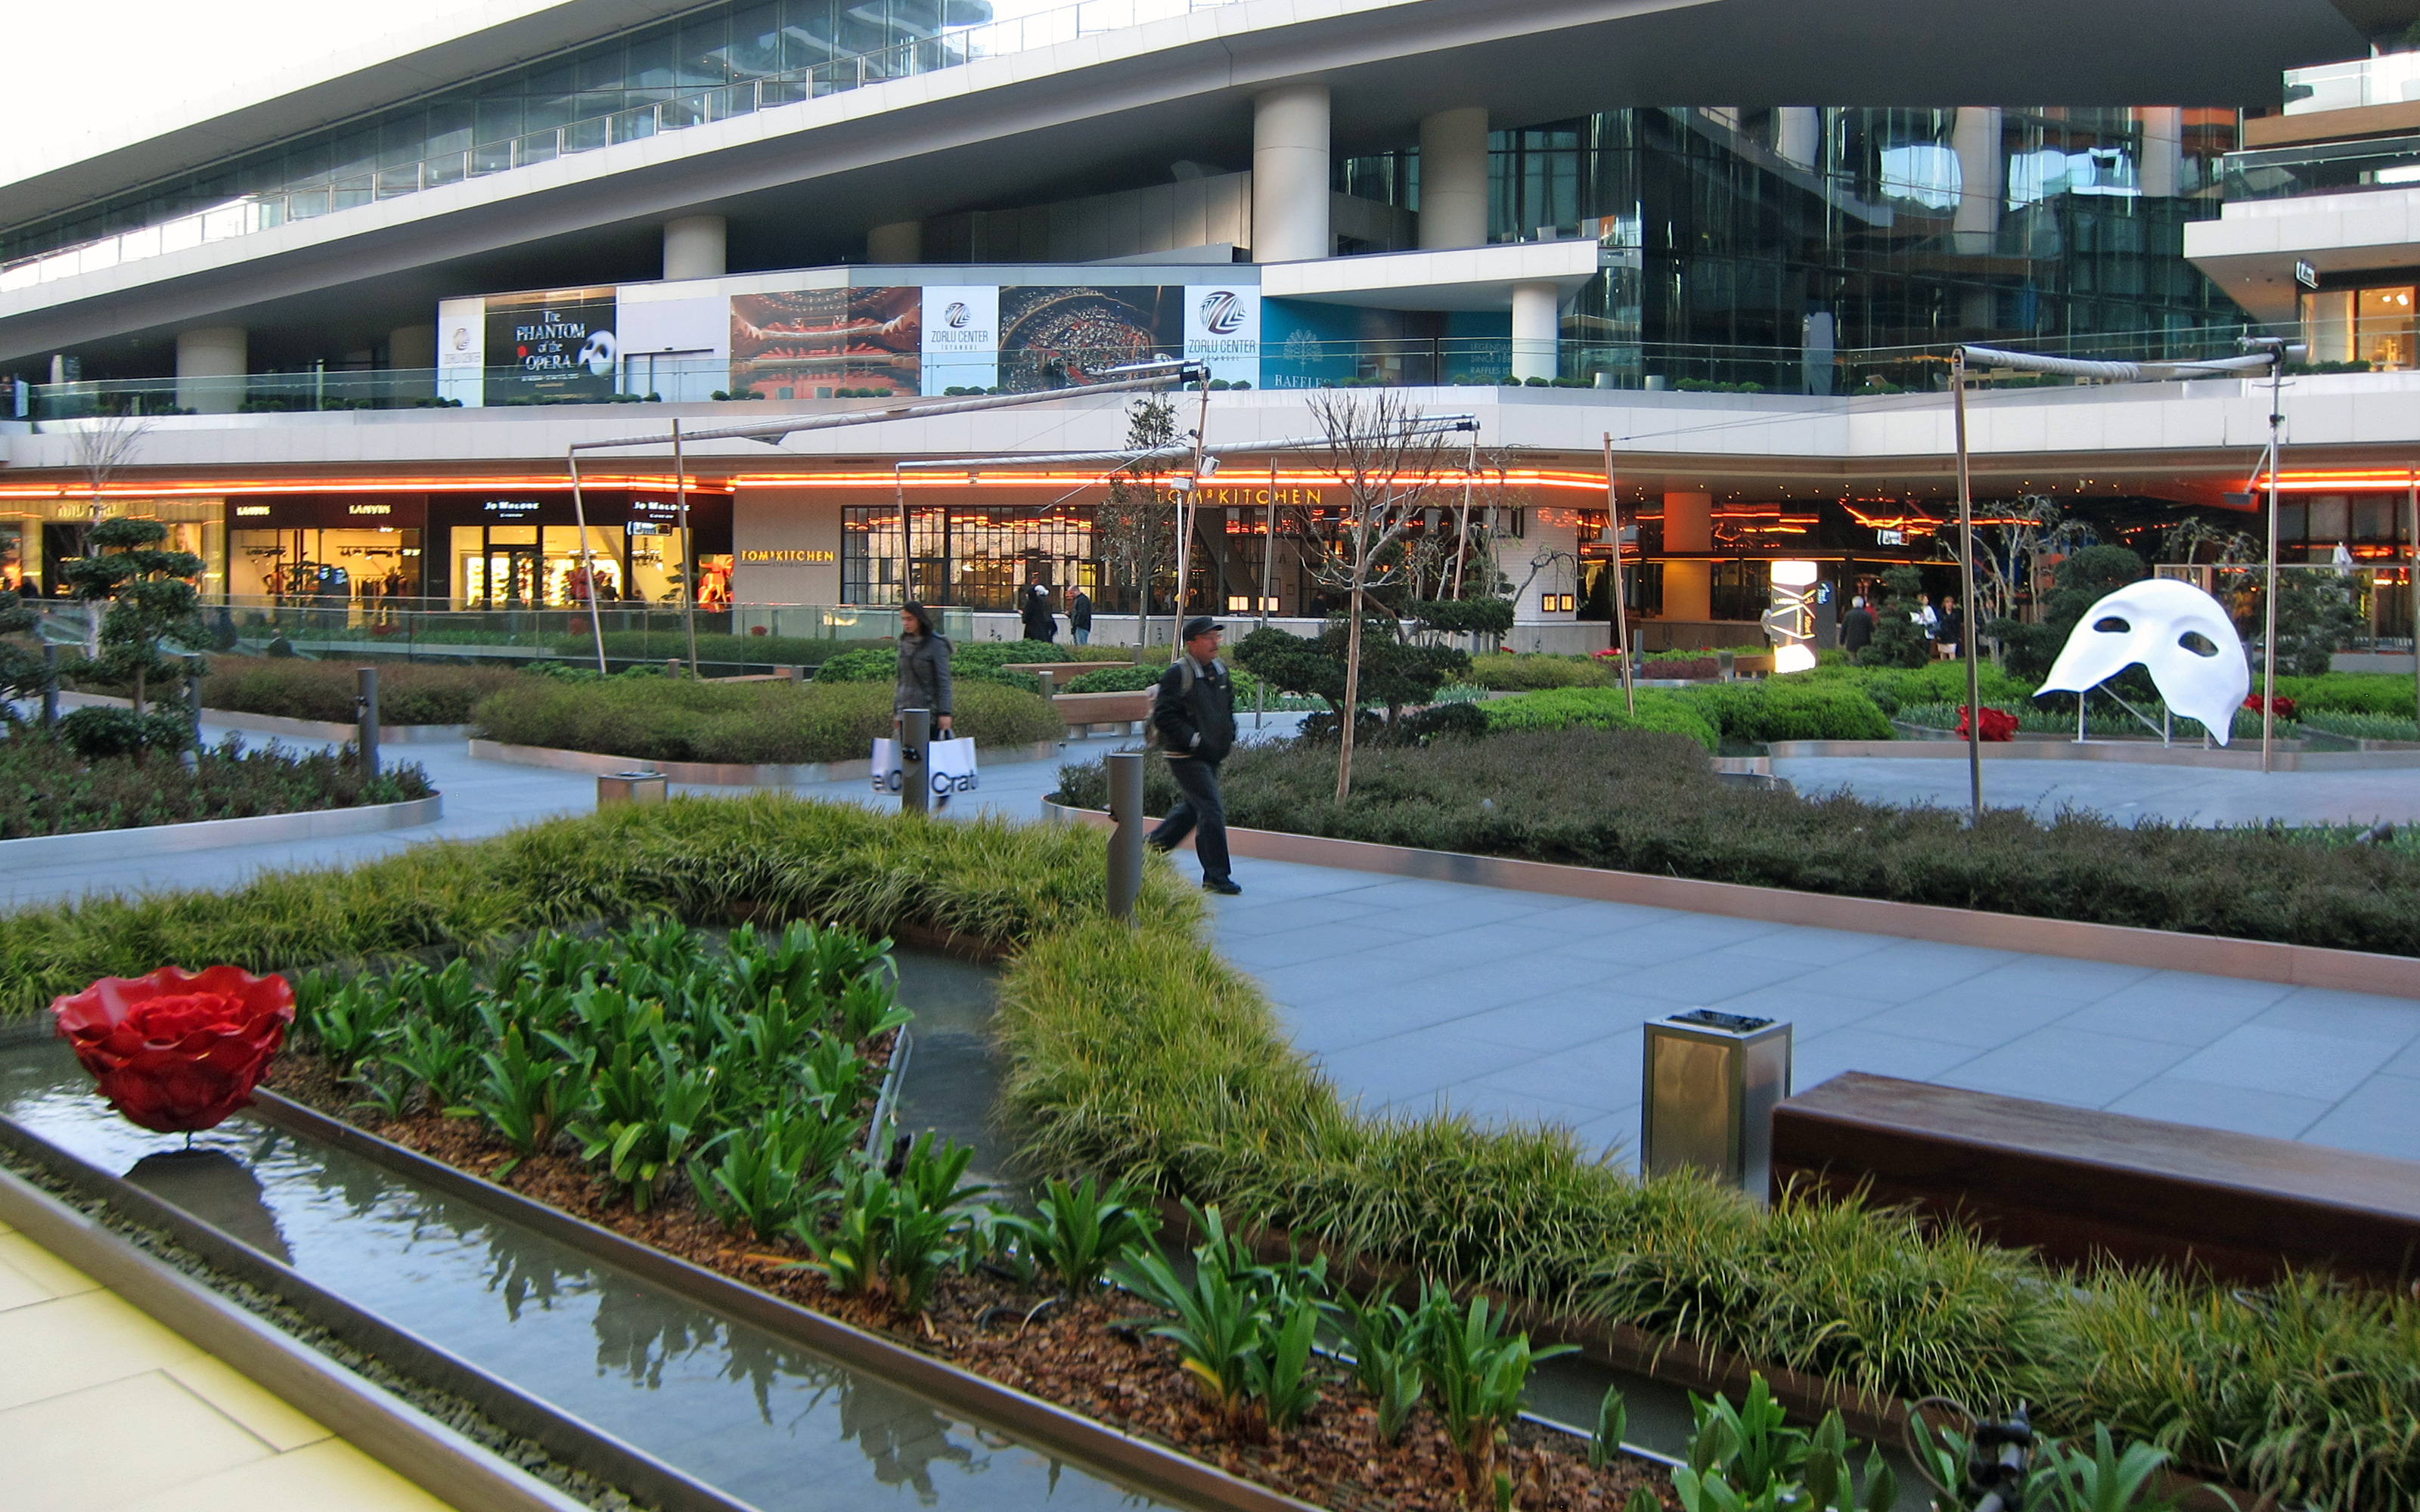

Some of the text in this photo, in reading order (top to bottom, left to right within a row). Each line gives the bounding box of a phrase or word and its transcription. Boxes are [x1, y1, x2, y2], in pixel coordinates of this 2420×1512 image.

[544, 311, 561, 323] The
[517, 323, 585, 342] PHANTOM
[931, 330, 988, 342] ZORLU CENTER
[1188, 339, 1255, 353] ZORLU CENTER
[526, 354, 573, 371] OPERA
[1219, 488, 1321, 505] KITCHEN
[776, 550, 834, 561] KITCHEN
